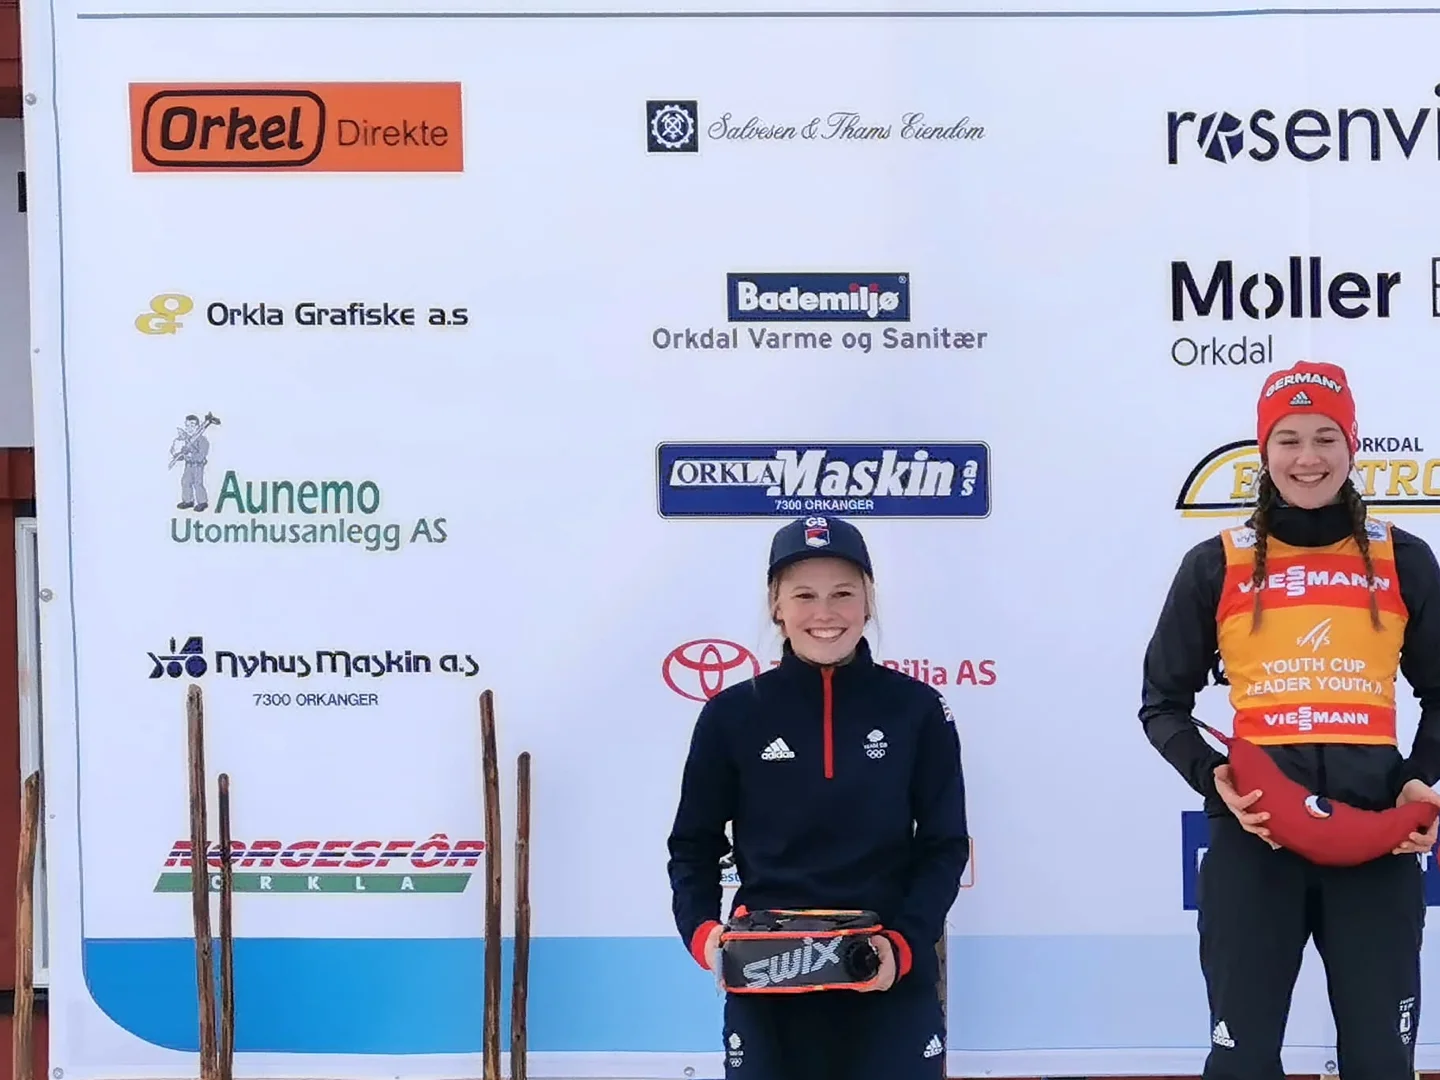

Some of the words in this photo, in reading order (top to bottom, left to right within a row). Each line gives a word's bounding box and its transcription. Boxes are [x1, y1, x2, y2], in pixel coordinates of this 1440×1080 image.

[160, 106, 304, 152] Orkel
[338, 119, 449, 147] Direkte
[707, 112, 797, 140] Salvesen
[801, 113, 818, 140] &
[821, 111, 892, 140] Thams
[900, 112, 986, 140] Eiendom
[738, 281, 899, 319] Bademiljø
[207, 302, 283, 326] Orkla
[295, 302, 415, 326] Grafiske
[429, 305, 468, 326] a.s
[653, 328, 738, 350] Orkdal
[748, 328, 832, 350] Varme
[842, 332, 872, 354] og
[883, 327, 988, 350] Sanitær
[1171, 335, 1273, 366] Orkdal
[1265, 372, 1343, 397] GERMANY
[677, 463, 777, 484] ORKLA
[767, 449, 955, 496] Maskin
[214, 470, 380, 514] Aunemo
[775, 500, 802, 511] 7300
[804, 500, 874, 511] ORKANGER
[171, 518, 401, 551] Utomhusanlegg
[410, 518, 447, 544] AS
[805, 517, 828, 527] GB
[216, 650, 311, 679] Nyhus
[316, 650, 432, 678] Maskin
[439, 652, 480, 677] a.s
[956, 660, 997, 685] AS
[1262, 658, 1324, 674] YOUTH
[1330, 658, 1366, 673] CUP
[1315, 677, 1372, 693] YOUTH
[253, 693, 291, 706] 7300
[296, 693, 379, 707] ORKANGER
[1264, 706, 1369, 731] VIESSMANN
[761, 749, 796, 761] adidas
